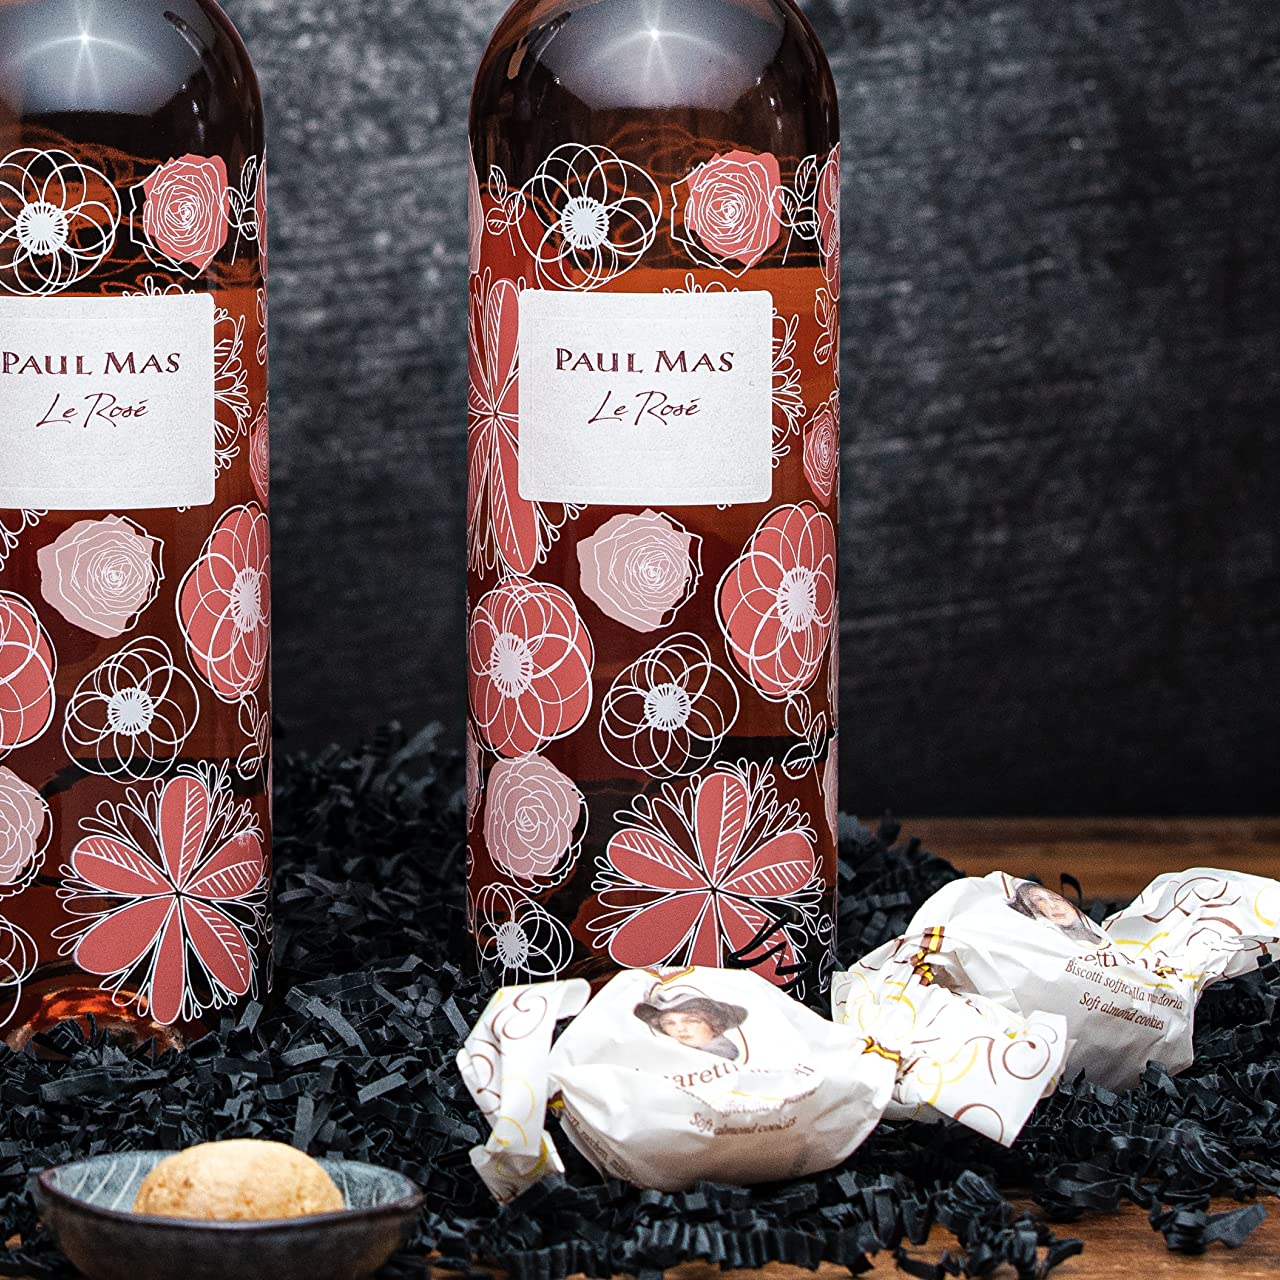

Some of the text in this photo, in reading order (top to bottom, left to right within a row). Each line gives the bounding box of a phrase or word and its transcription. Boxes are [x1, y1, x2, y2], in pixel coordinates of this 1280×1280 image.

[1, 350, 182, 375] PAUL MAS
[555, 347, 736, 373] PAUL MAS
[35, 392, 150, 428] Le Rosé
[587, 390, 703, 426] Le Rosé
[1065, 959, 1105, 985] Biscotti
[1079, 991, 1166, 1031] Soft almond cookies
